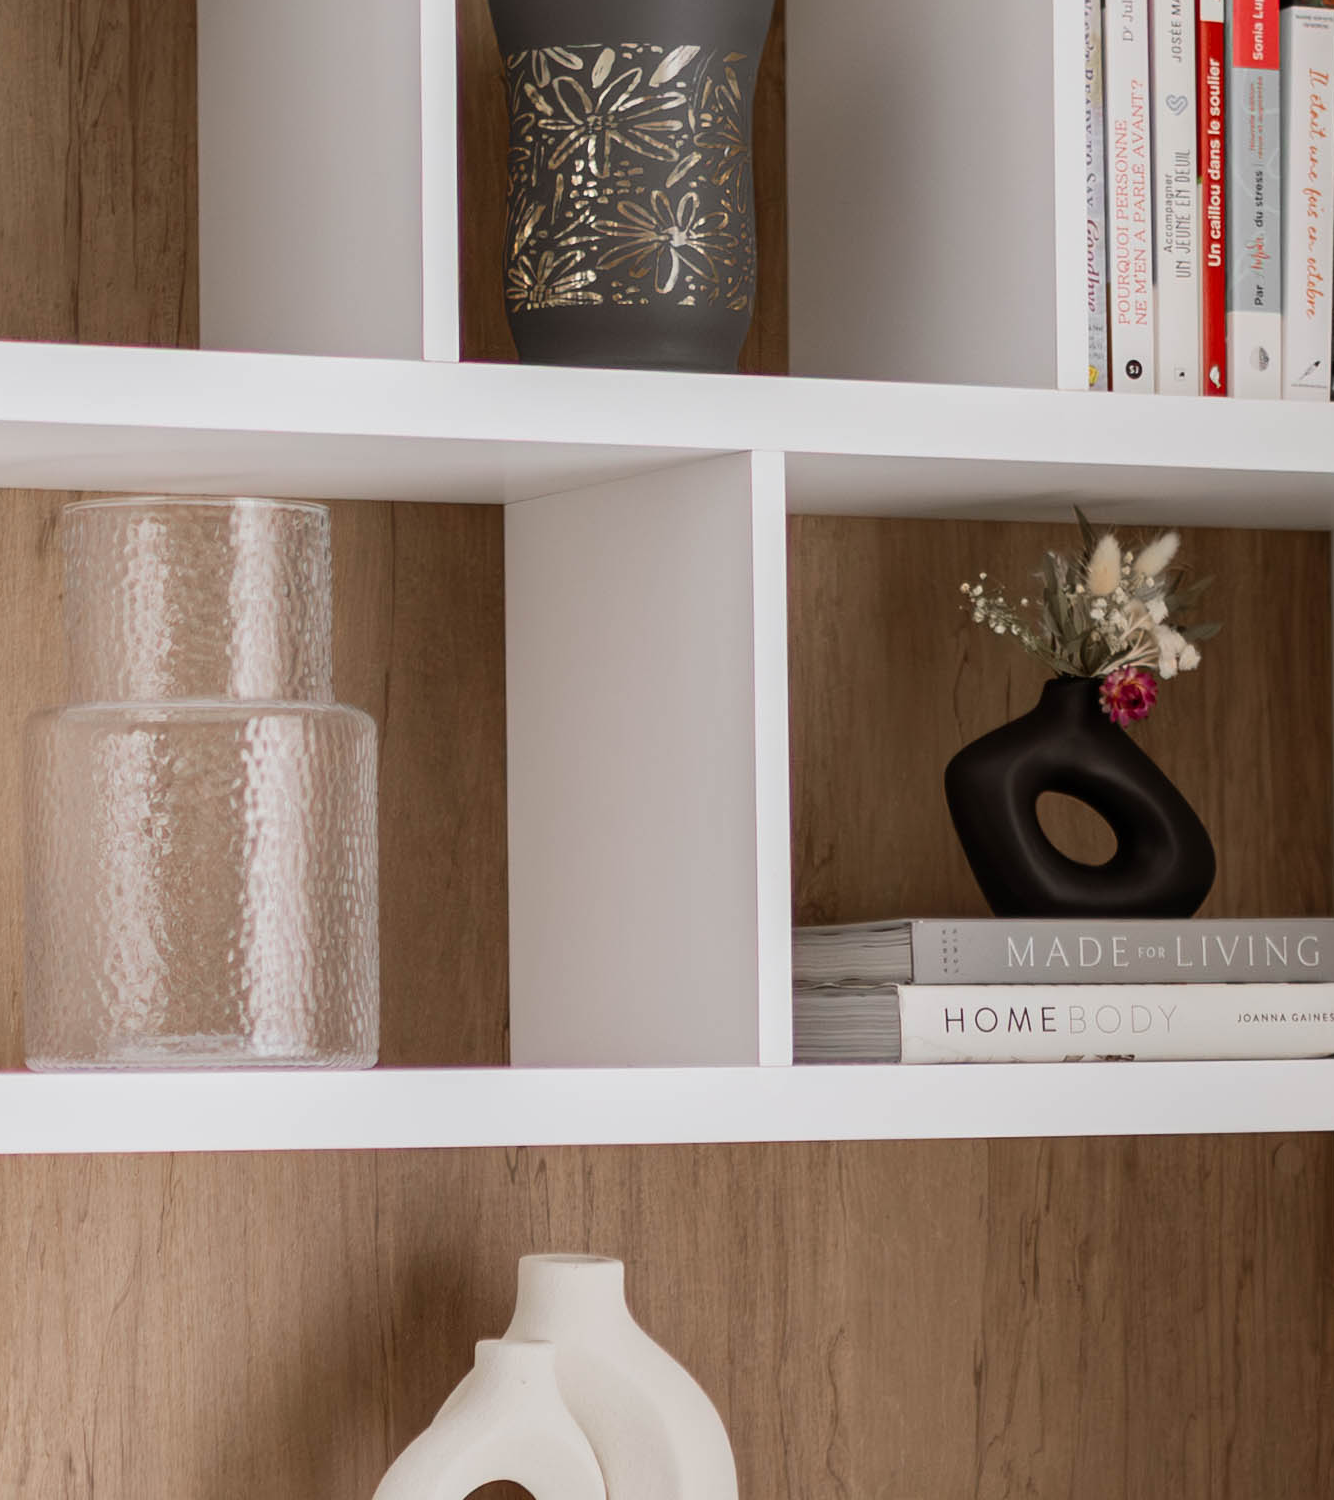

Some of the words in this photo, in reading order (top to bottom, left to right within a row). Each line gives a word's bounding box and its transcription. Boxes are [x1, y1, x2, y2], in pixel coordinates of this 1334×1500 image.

[1167, 20, 1182, 63] JOSÉE
[1252, 21, 1264, 61] Sonia
[1207, 57, 1220, 117] soulier
[1308, 67, 1330, 87] Il
[1206, 120, 1220, 135] le
[1114, 119, 1129, 221] PERSONNE
[1173, 149, 1189, 183] DEUIL
[1206, 139, 1220, 181] dans
[1307, 145, 1320, 182] une
[1131, 163, 1146, 224] PARLÉ
[1174, 189, 1190, 207] EN
[1253, 170, 1264, 207] stress
[1302, 187, 1325, 218] fois
[1163, 173, 1174, 254] Accompagner
[1207, 184, 1221, 240] caillou
[1253, 211, 1264, 228] du
[1133, 229, 1146, 243] A
[1174, 213, 1191, 254] JEUNE
[1307, 225, 1320, 252] en
[1133, 248, 1147, 294] M'EN
[1174, 260, 1191, 279] UN
[1207, 243, 1221, 267] Un
[1116, 226, 1132, 325] POURQUOI
[1306, 256, 1324, 321] octobre
[1134, 299, 1148, 326] NE
[1253, 285, 1264, 307] Par
[1007, 935, 1131, 968] MADE
[1137, 946, 1166, 960] FOR
[1176, 935, 1322, 968] LIVING
[945, 1004, 1178, 1034] HOMEBODY
[1237, 1013, 1287, 1024] JOANNA
